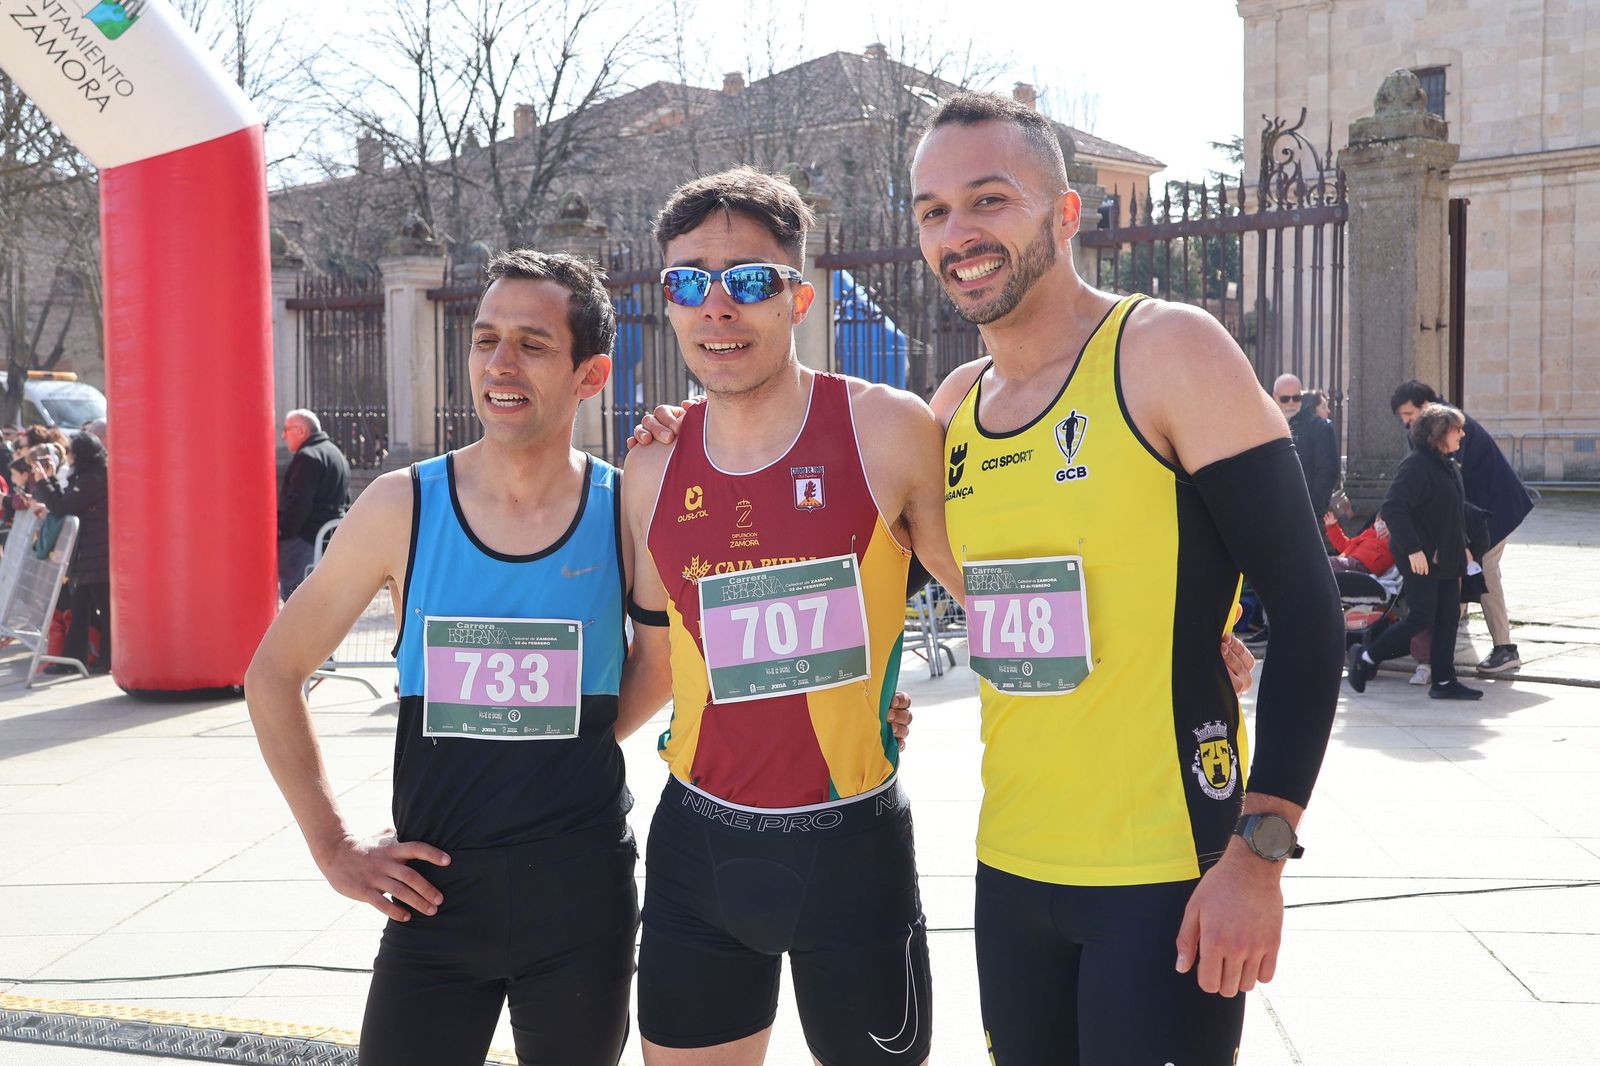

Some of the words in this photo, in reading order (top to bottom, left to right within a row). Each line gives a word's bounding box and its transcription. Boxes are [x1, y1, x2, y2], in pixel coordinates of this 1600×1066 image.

[9, 5, 112, 114] ZAMORA
[981, 456, 998, 471] CCI
[999, 449, 1034, 468] SPORT
[1056, 466, 1087, 482] GCB
[730, 540, 760, 548] ZAMORA
[728, 574, 767, 584] Carrera
[810, 576, 833, 584] ZAMORA
[972, 567, 1002, 575] Carrera
[456, 622, 495, 630] Carrera
[730, 596, 829, 660] 707
[974, 597, 1055, 654] 748
[454, 652, 550, 703] 733
[682, 790, 755, 830] NIKE
[758, 810, 843, 833] PRO
